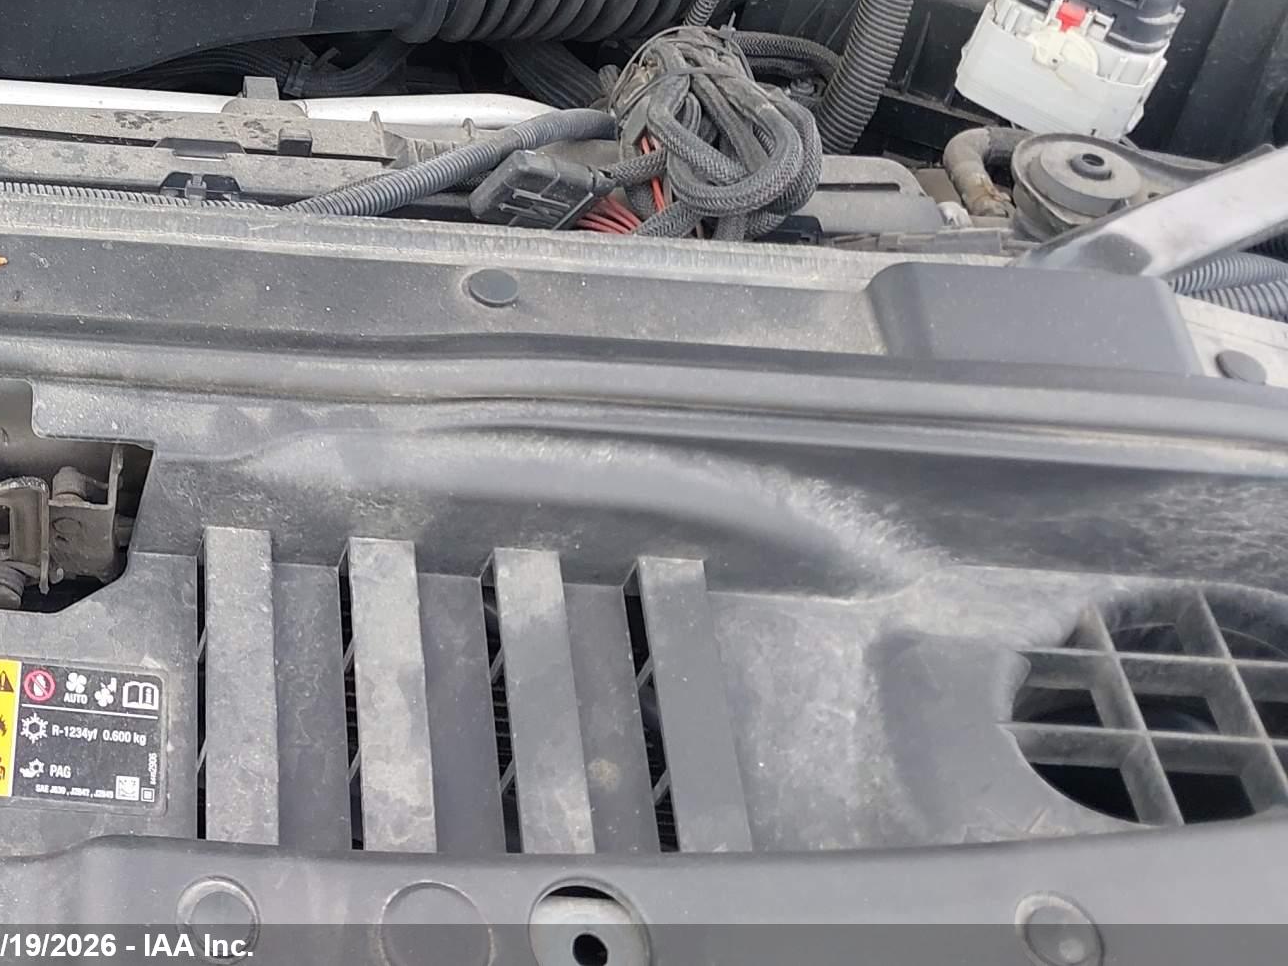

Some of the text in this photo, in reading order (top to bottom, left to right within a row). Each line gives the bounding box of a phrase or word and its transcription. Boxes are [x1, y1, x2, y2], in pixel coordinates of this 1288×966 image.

[63, 692, 88, 705] AUTO
[52, 724, 147, 746] R-1234yf 0.600 kg
[49, 764, 72, 778] PAG
